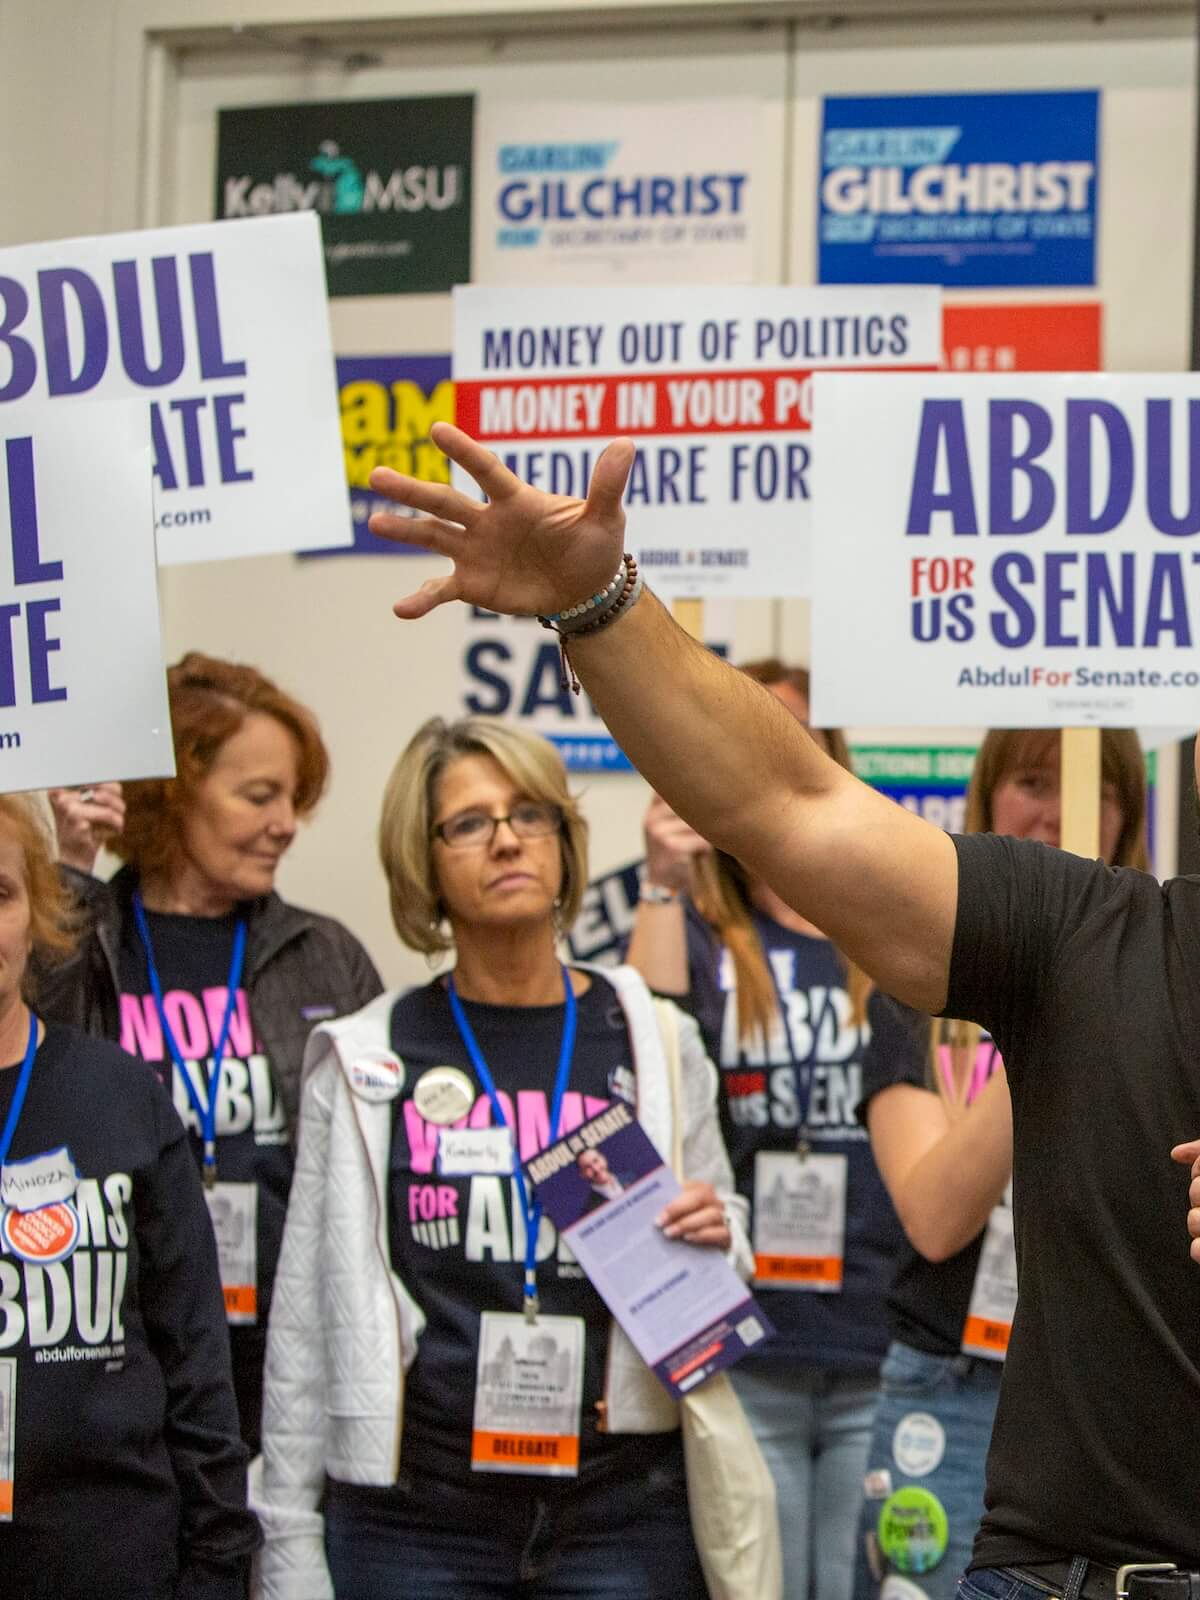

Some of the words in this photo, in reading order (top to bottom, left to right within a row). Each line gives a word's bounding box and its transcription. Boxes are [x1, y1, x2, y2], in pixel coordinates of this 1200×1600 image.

[364, 166, 458, 212] MSU
[499, 174, 747, 221] GILCHRIST
[823, 161, 1093, 215] GILCHRIST
[483, 325, 604, 369] MONEY
[620, 322, 683, 363] OUT
[701, 320, 740, 360] OF
[755, 314, 909, 359] POLITICS
[480, 383, 605, 436] MONEY
[616, 384, 657, 429] IN
[668, 378, 765, 427] YOUR
[483, 445, 707, 505] EDIARE
[730, 442, 812, 503] FOR
[911, 556, 975, 598] FOR
[911, 593, 974, 644] US
[408, 1184, 458, 1222] FOR
[493, 1438, 559, 1458] DELEGATE
